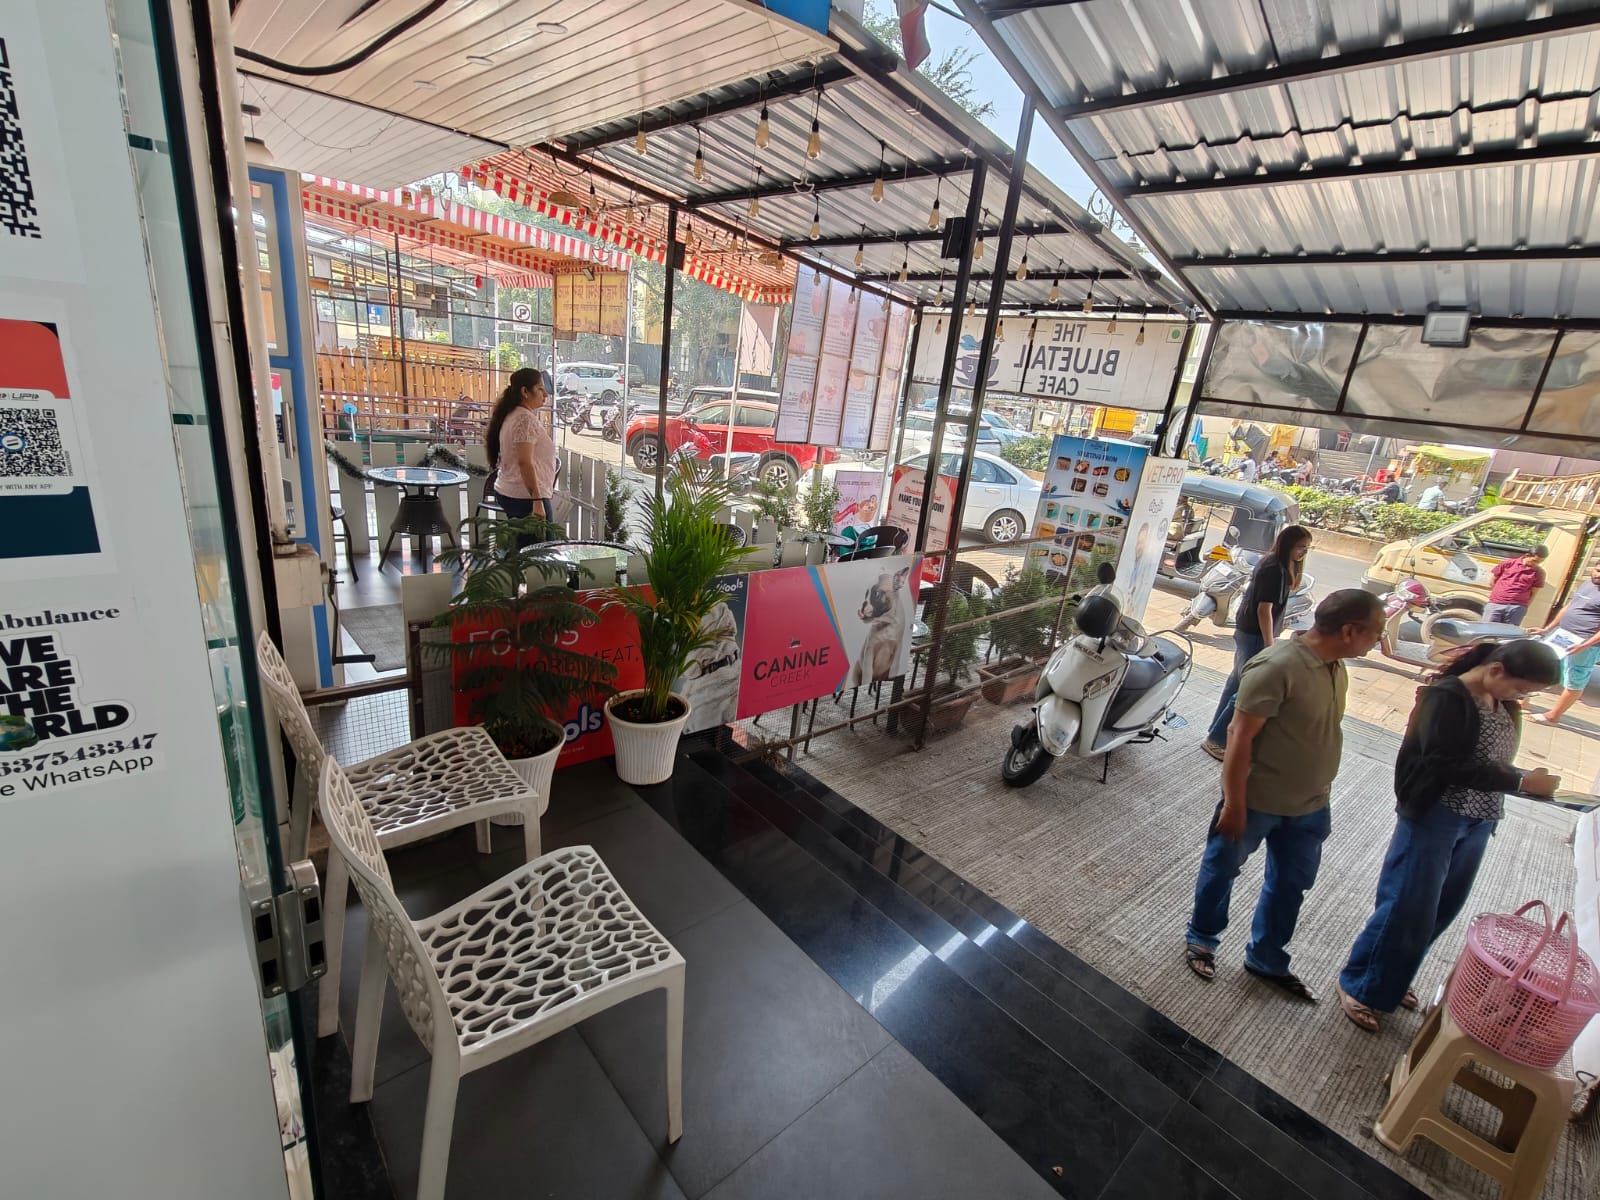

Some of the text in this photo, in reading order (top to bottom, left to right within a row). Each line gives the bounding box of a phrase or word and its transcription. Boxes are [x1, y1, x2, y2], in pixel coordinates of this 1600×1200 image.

[753, 646, 830, 681] CANINE
[770, 669, 810, 688] CREEK
[22, 755, 154, 791] WhatsApp
